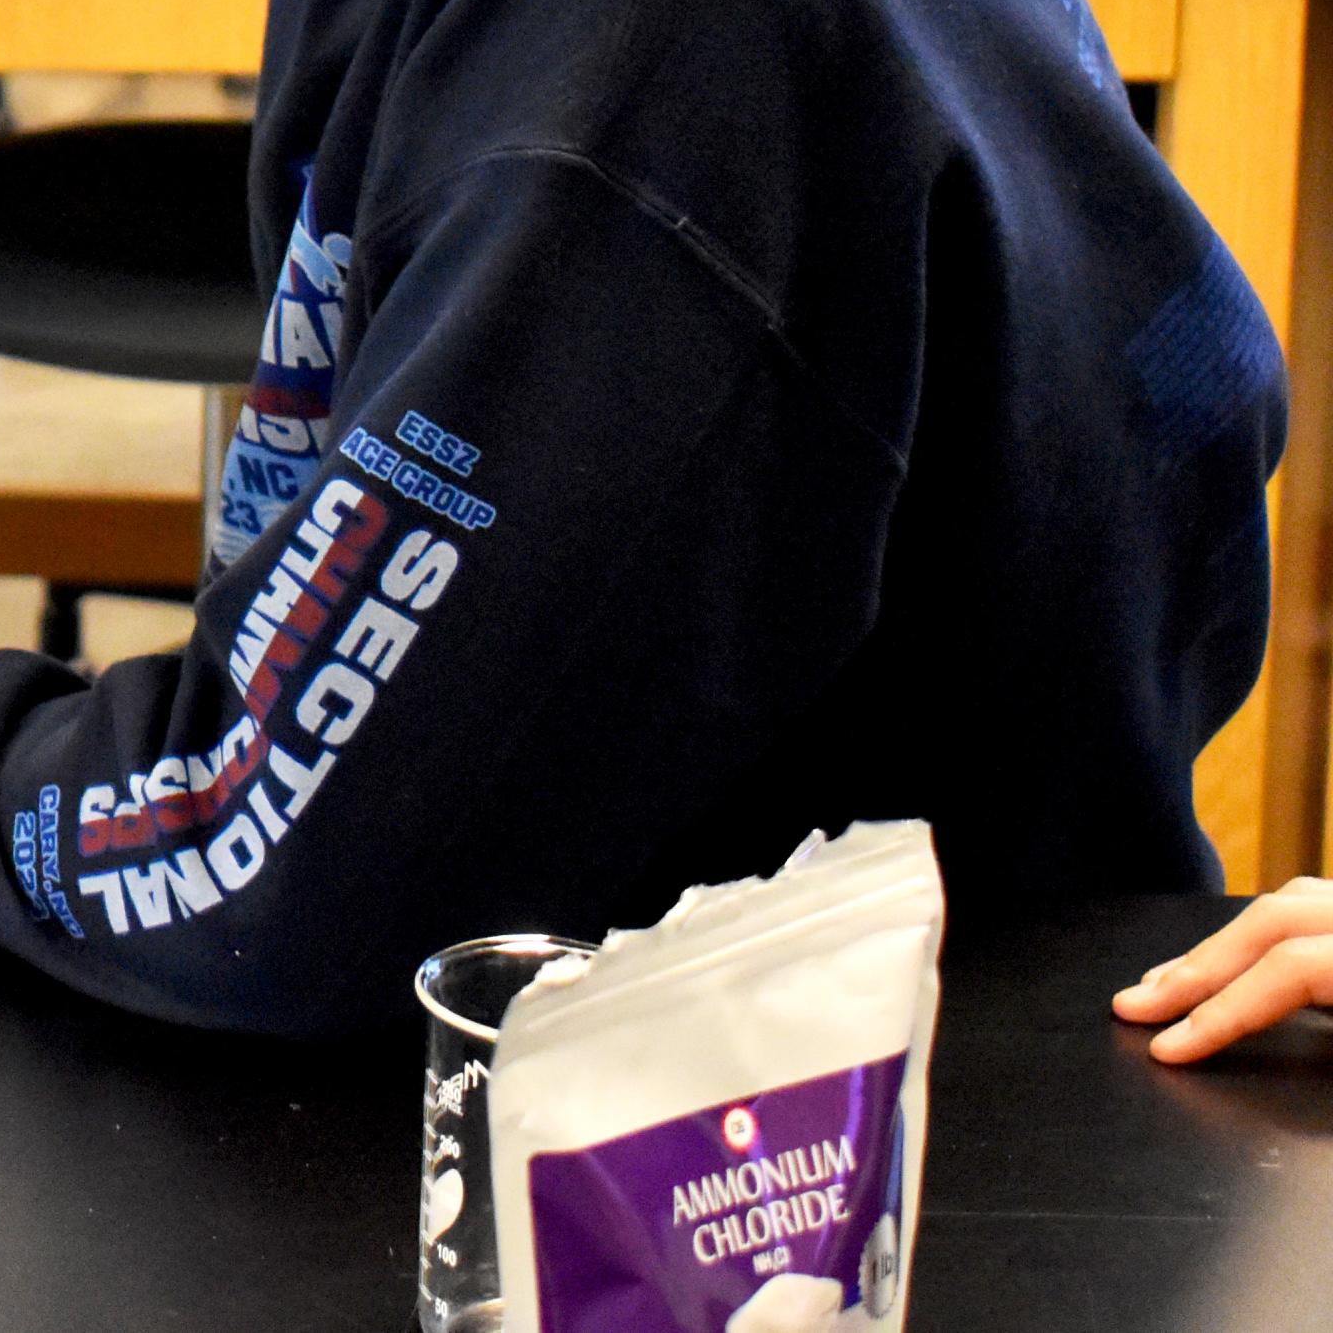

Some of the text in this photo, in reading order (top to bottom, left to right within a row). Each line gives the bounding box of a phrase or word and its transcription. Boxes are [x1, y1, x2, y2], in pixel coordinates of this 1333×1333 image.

[395, 410, 482, 478] ESSZ
[391, 460, 497, 531] GROUP
[77, 529, 459, 935] SECTIONAL
[672, 1133, 858, 1228] AMMONIUM
[691, 1182, 852, 1265] CHLORIDE
[434, 1298, 449, 1318] 50
